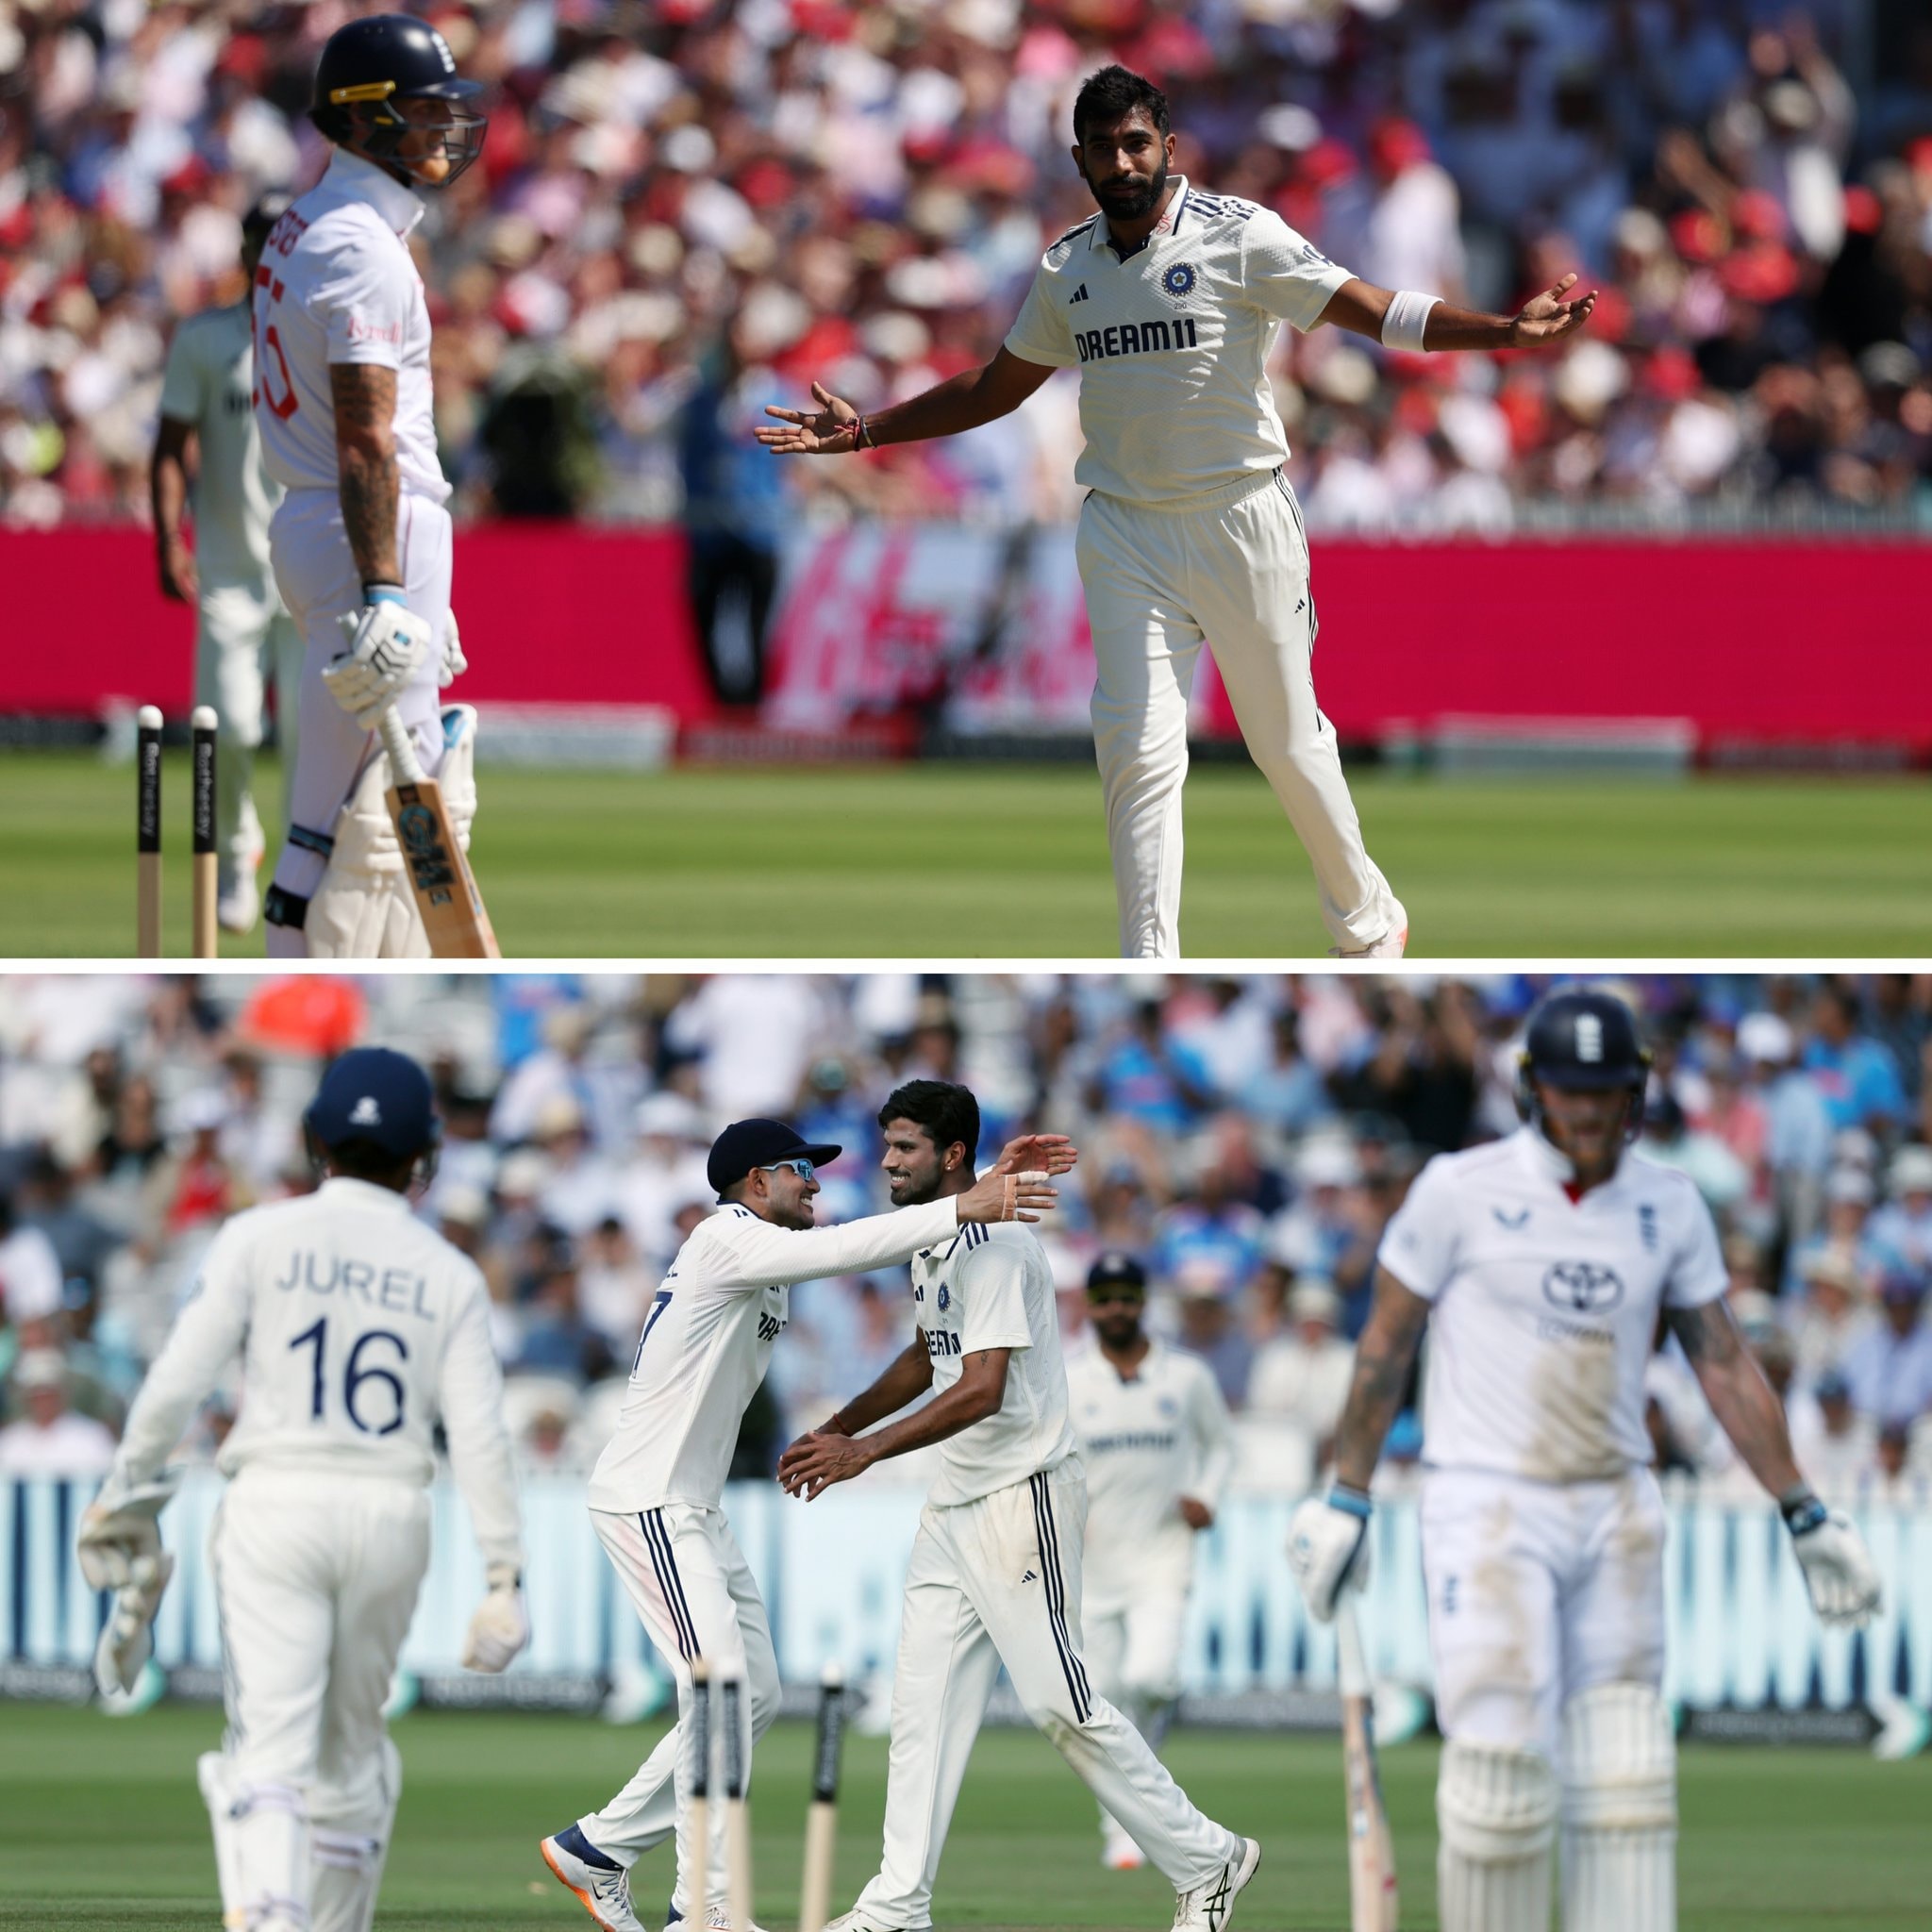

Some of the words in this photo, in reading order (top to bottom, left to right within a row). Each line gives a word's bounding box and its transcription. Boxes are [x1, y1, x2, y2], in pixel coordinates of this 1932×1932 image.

[1074, 318, 1197, 362] DREAM11
[276, 1251, 436, 1321] JUREL
[288, 1315, 408, 1436] 16
